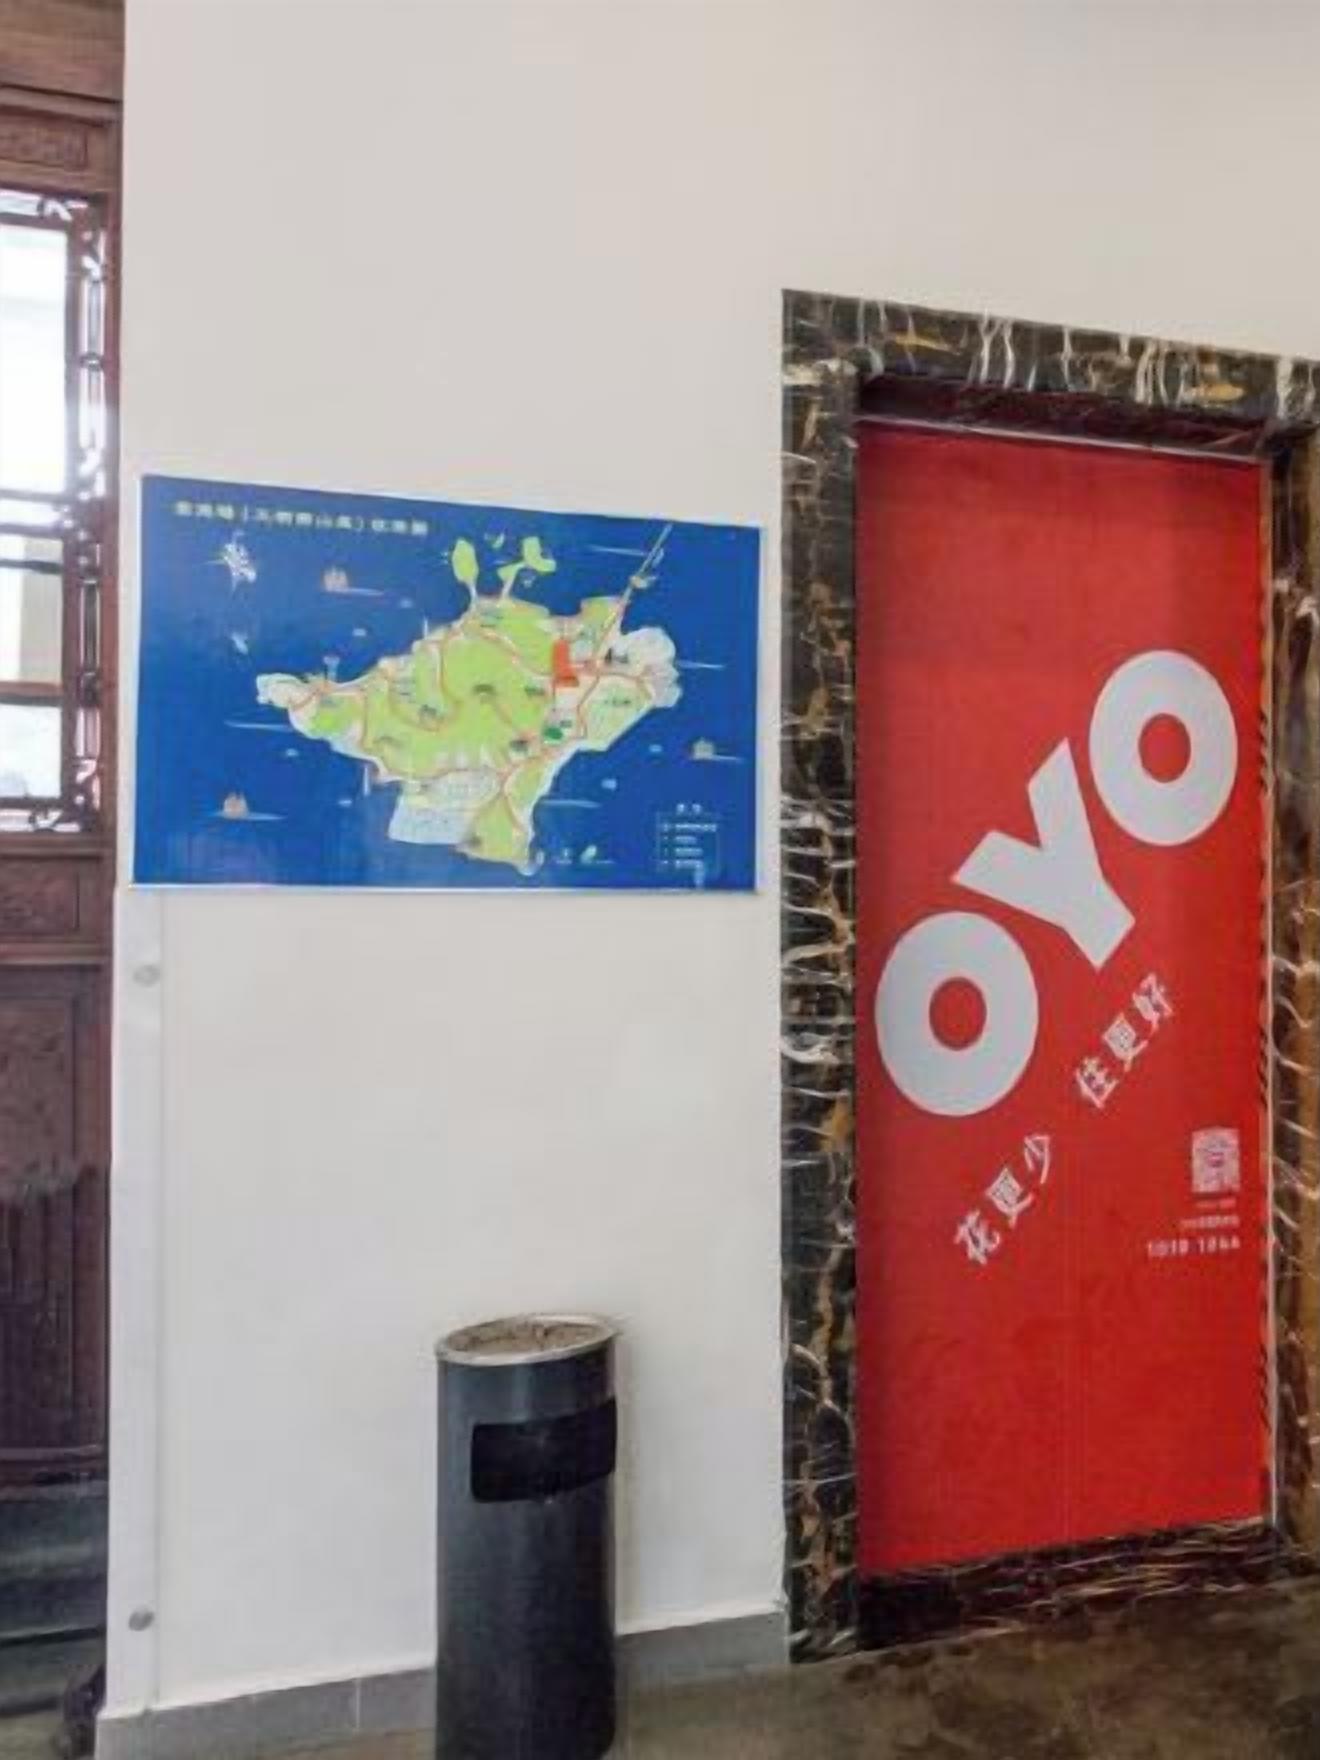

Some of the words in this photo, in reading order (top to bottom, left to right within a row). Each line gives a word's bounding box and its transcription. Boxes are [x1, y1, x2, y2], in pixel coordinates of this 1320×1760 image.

[875, 650, 1238, 1117] OYO
[954, 1134, 1051, 1265] 花更少
[1075, 972, 1173, 1109] 住更好
